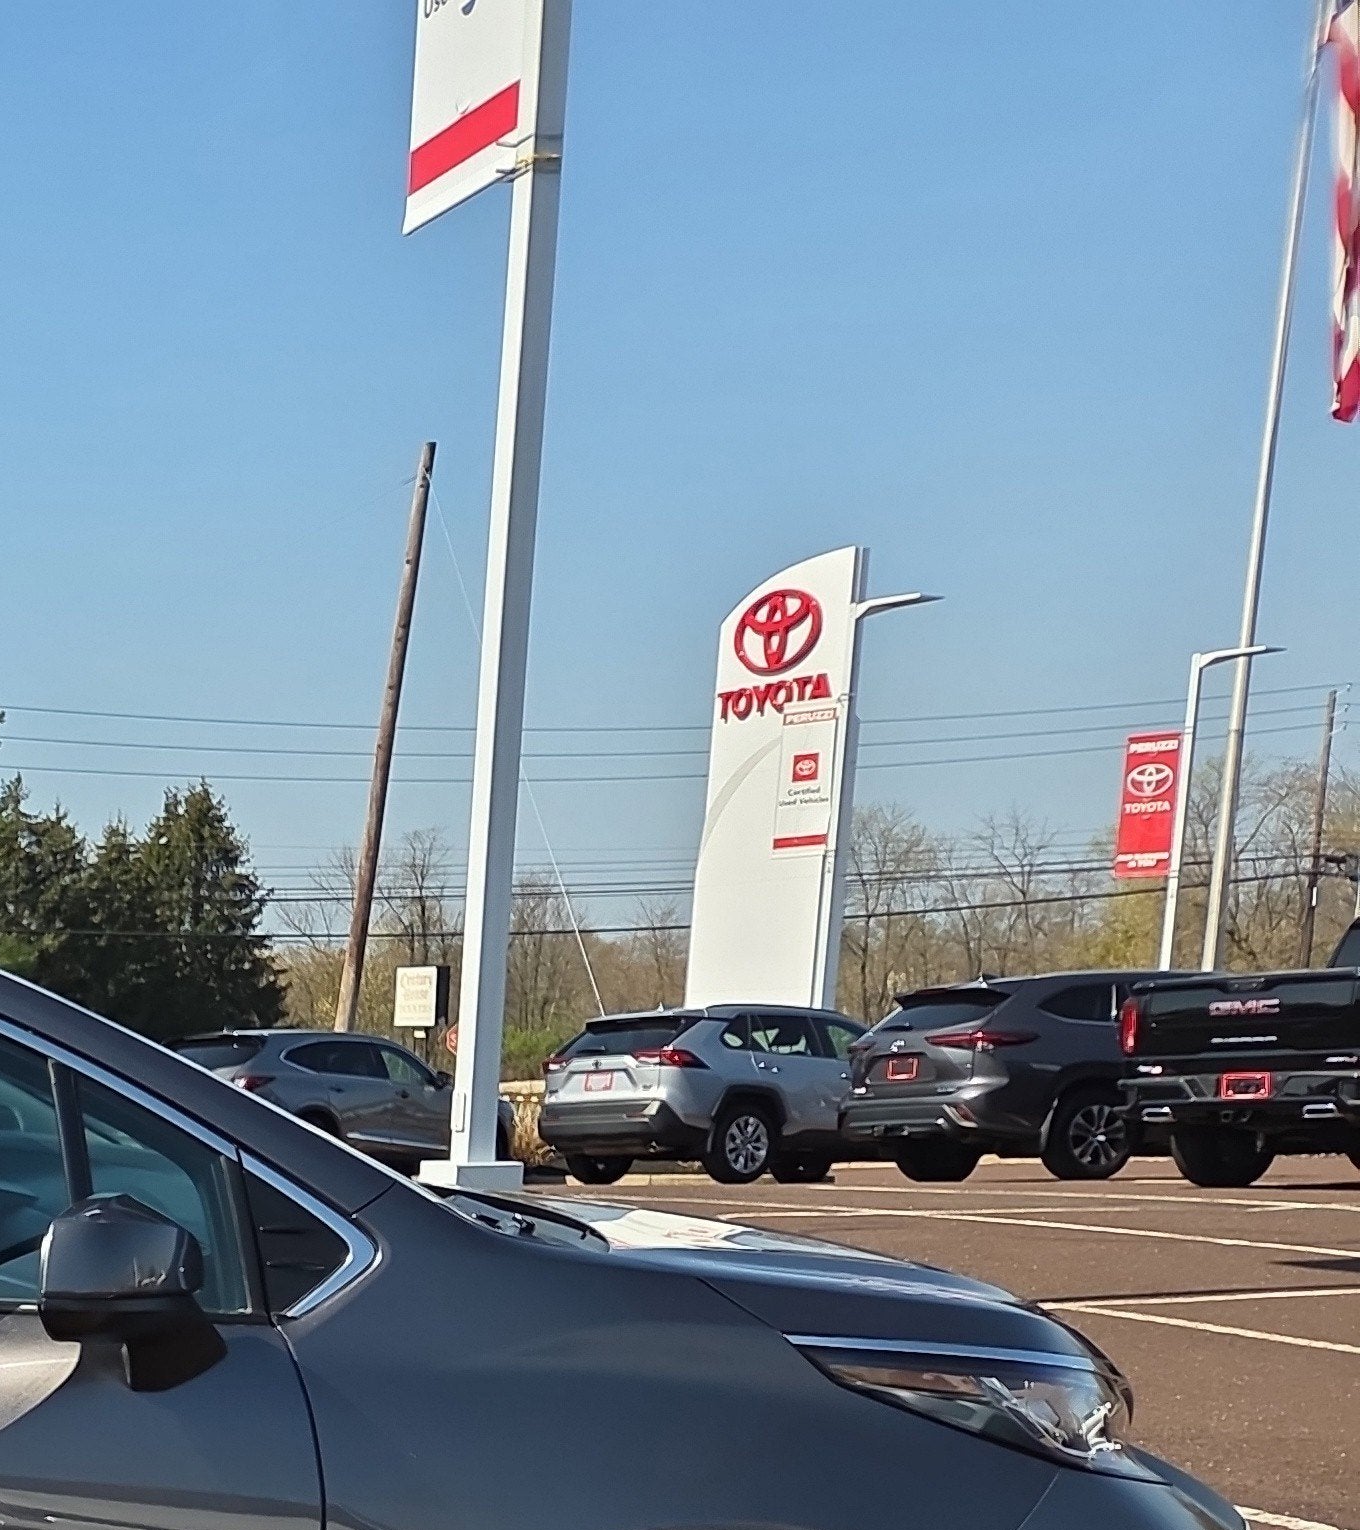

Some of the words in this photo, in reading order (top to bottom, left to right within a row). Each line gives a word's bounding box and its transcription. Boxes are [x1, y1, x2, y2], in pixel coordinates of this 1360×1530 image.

[717, 673, 833, 724] TOYOTA
[1124, 801, 1172, 814] TOYOTA
[1209, 998, 1280, 1017] GMC
